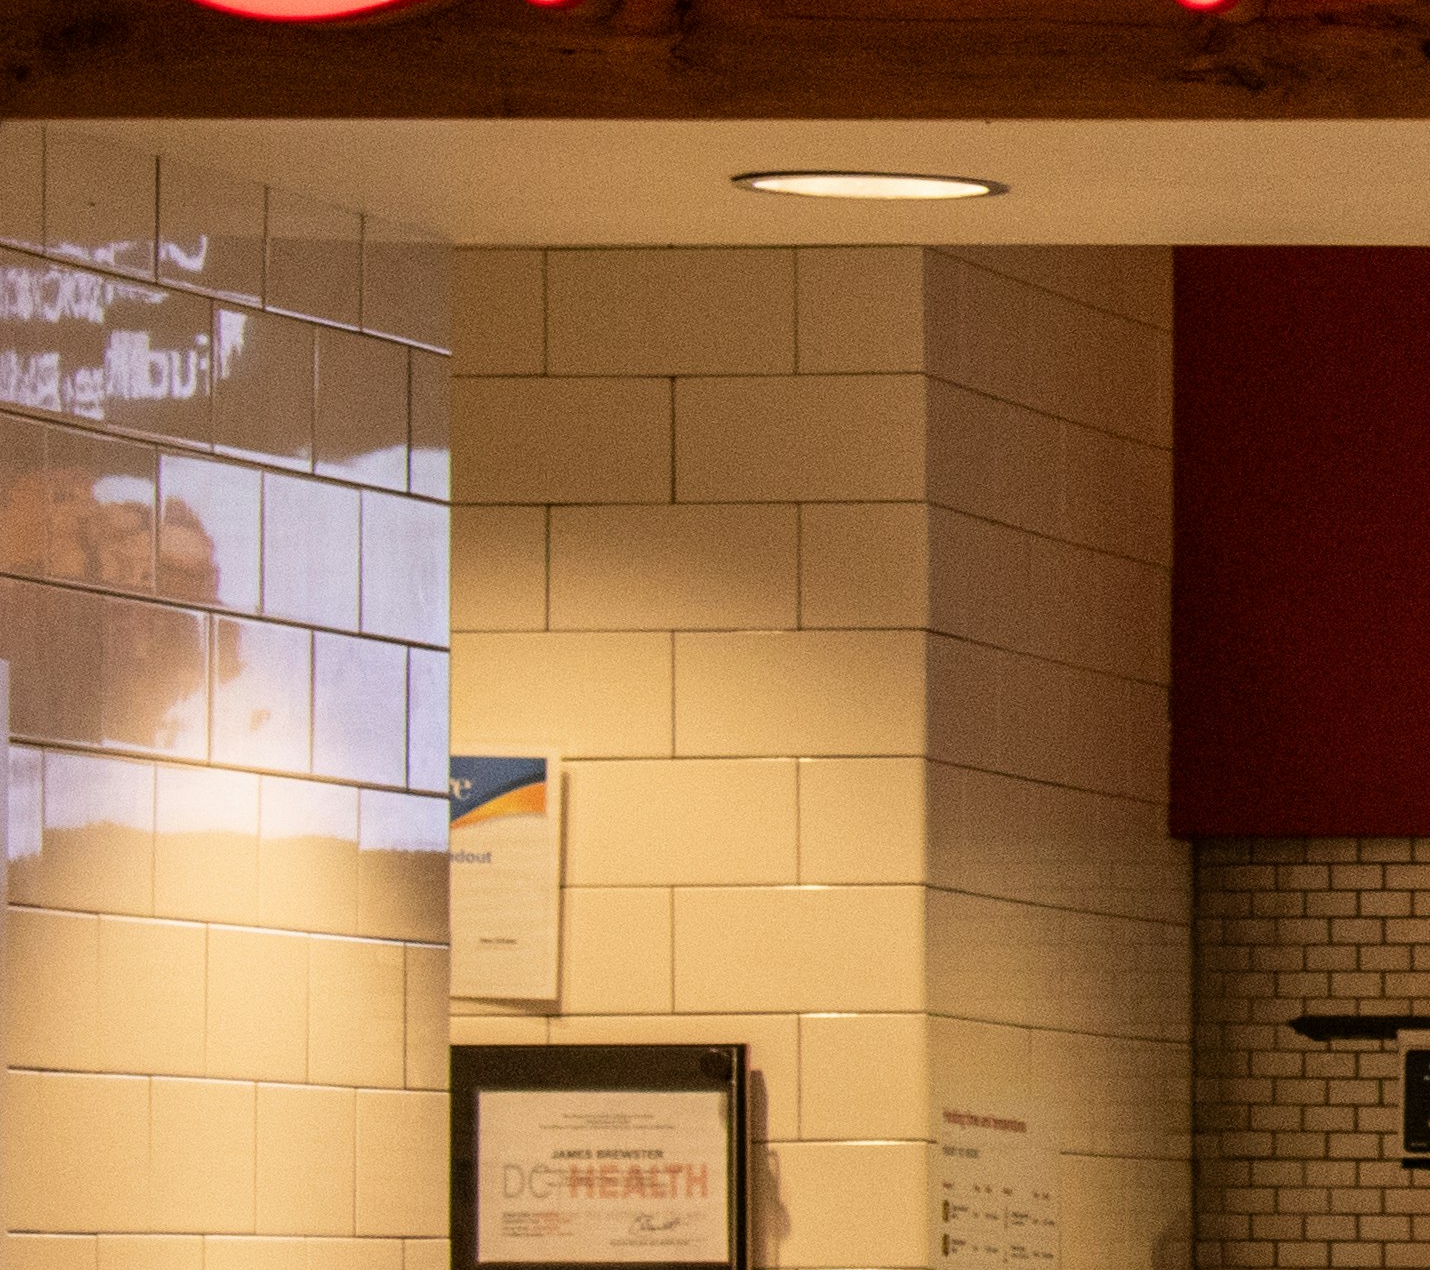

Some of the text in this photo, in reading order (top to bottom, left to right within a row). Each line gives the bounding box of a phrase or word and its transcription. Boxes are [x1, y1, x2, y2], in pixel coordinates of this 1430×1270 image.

[552, 1150, 663, 1160] JAMES BREWSTER
[570, 1163, 709, 1199] HEALTH
